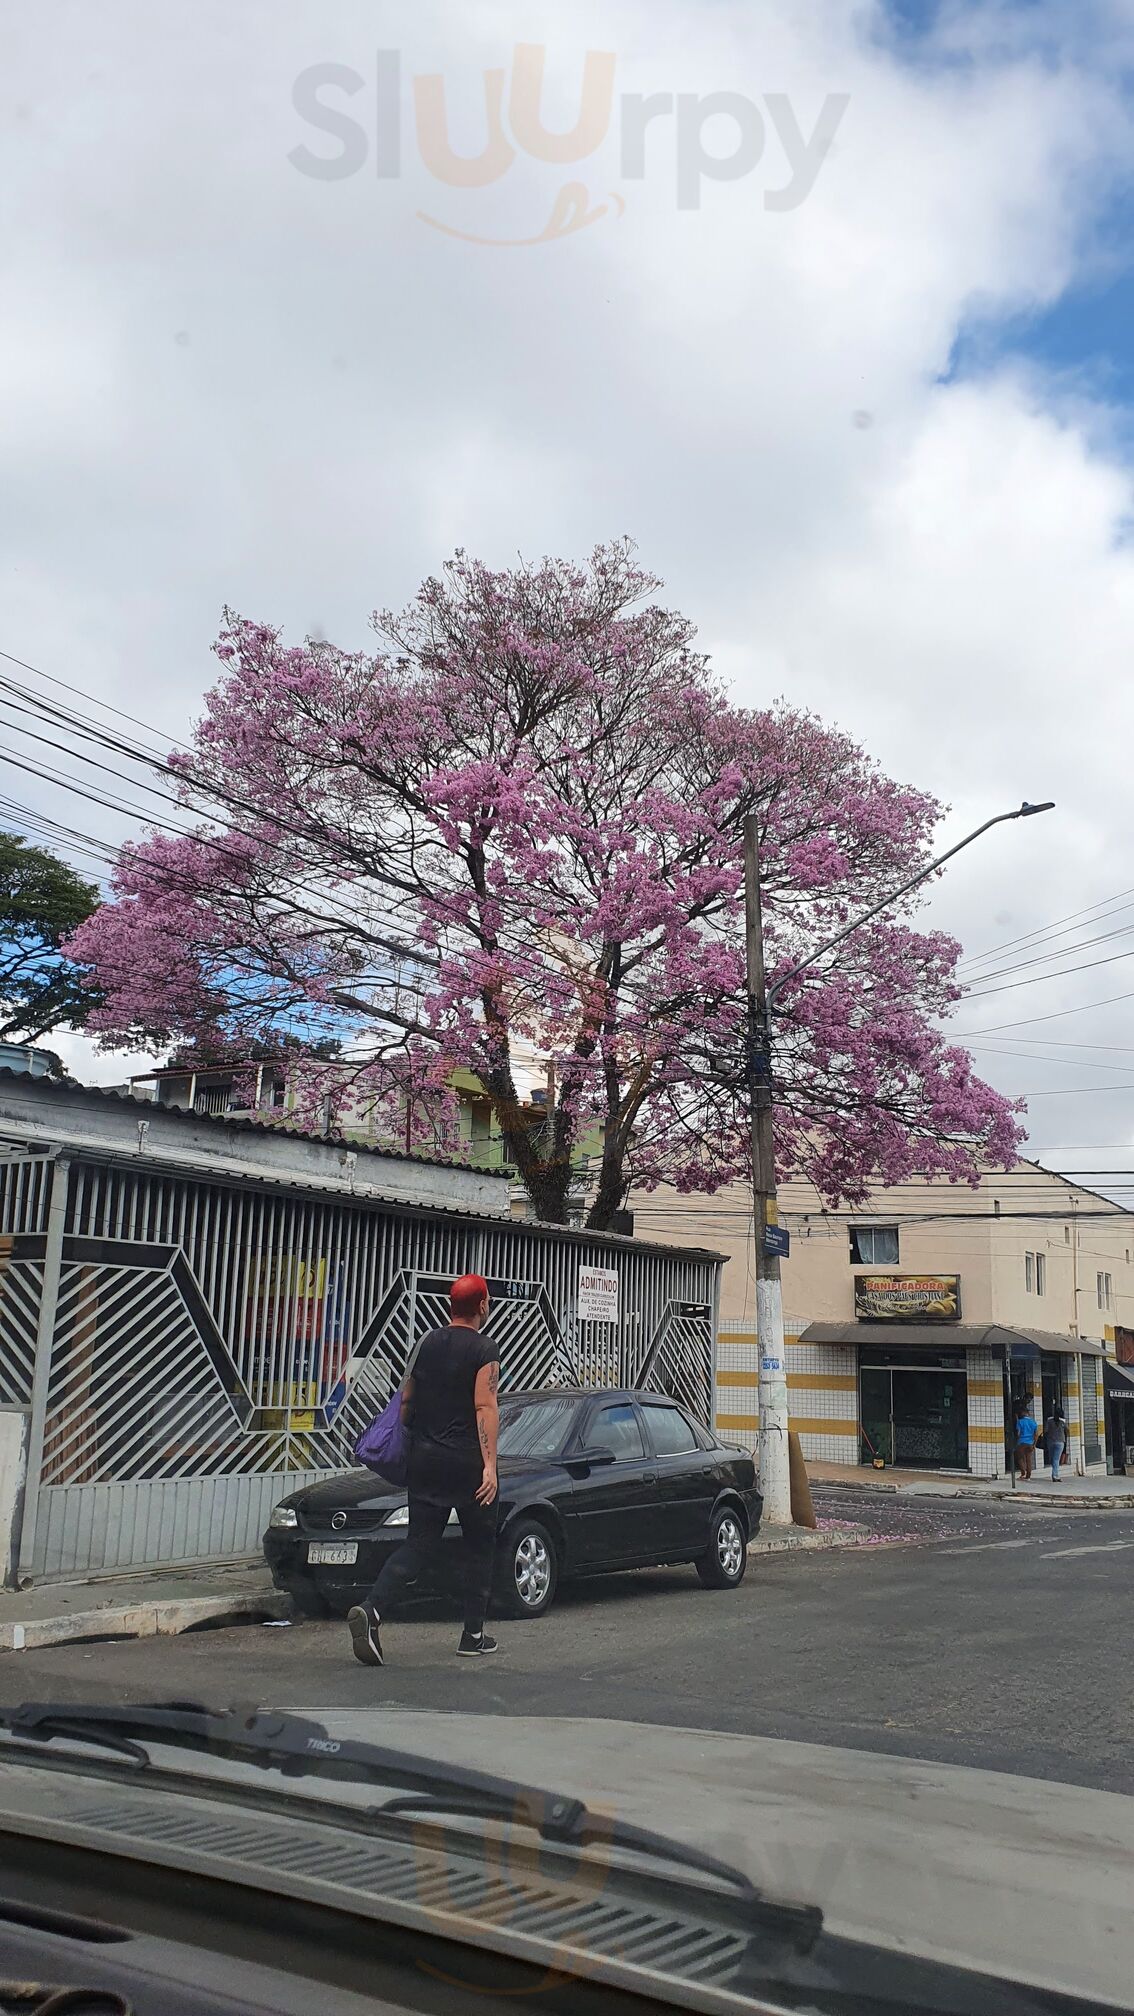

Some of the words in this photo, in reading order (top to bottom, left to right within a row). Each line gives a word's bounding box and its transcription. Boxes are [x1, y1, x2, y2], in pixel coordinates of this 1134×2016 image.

[580, 1276, 617, 1293] ADMITINDO
[866, 1282, 945, 1291] PANIFICADORA
[306, 1738, 340, 1752] TRICO
